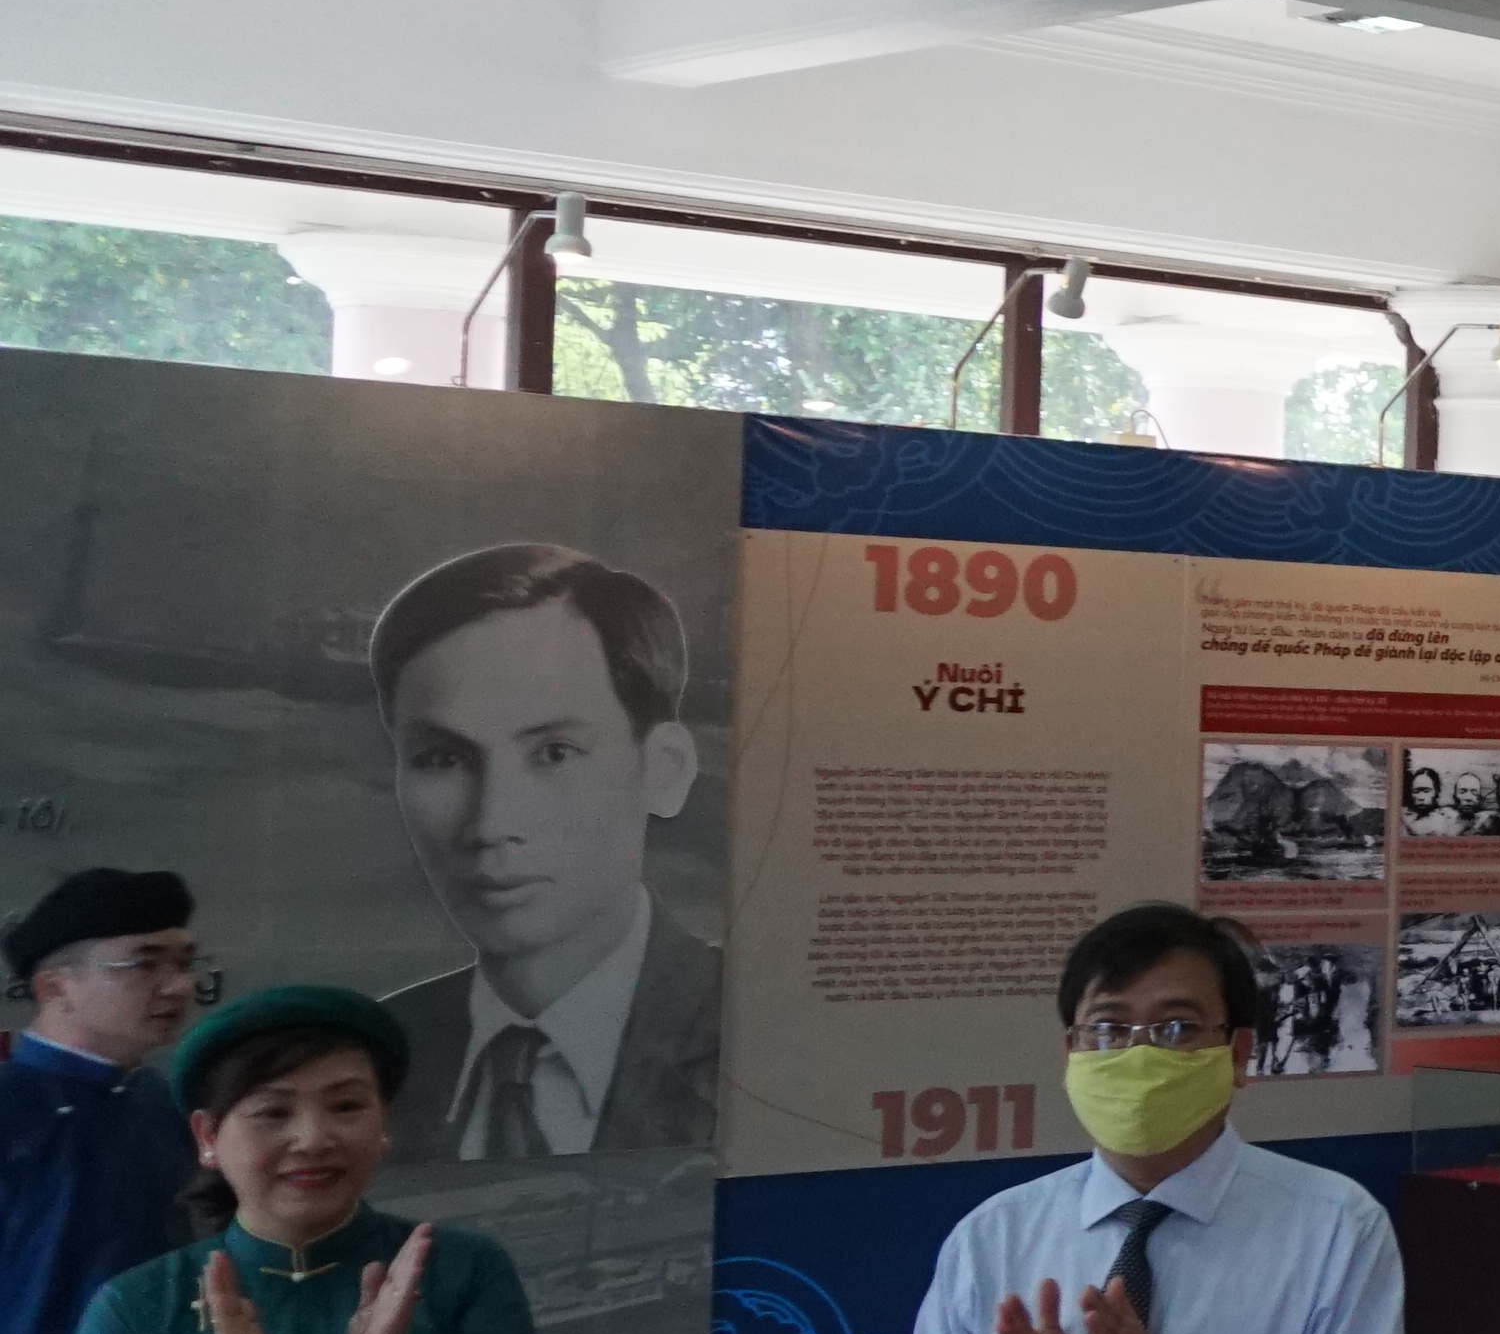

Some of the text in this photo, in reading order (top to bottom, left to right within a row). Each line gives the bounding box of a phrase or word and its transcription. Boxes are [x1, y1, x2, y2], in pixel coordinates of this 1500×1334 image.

[865, 545, 1077, 621] 1890
[1314, 642, 1351, 659] Pháp
[937, 662, 1003, 684] Nuôi
[913, 678, 1025, 714] Ý CHÍ
[872, 1084, 1036, 1159] 1911
